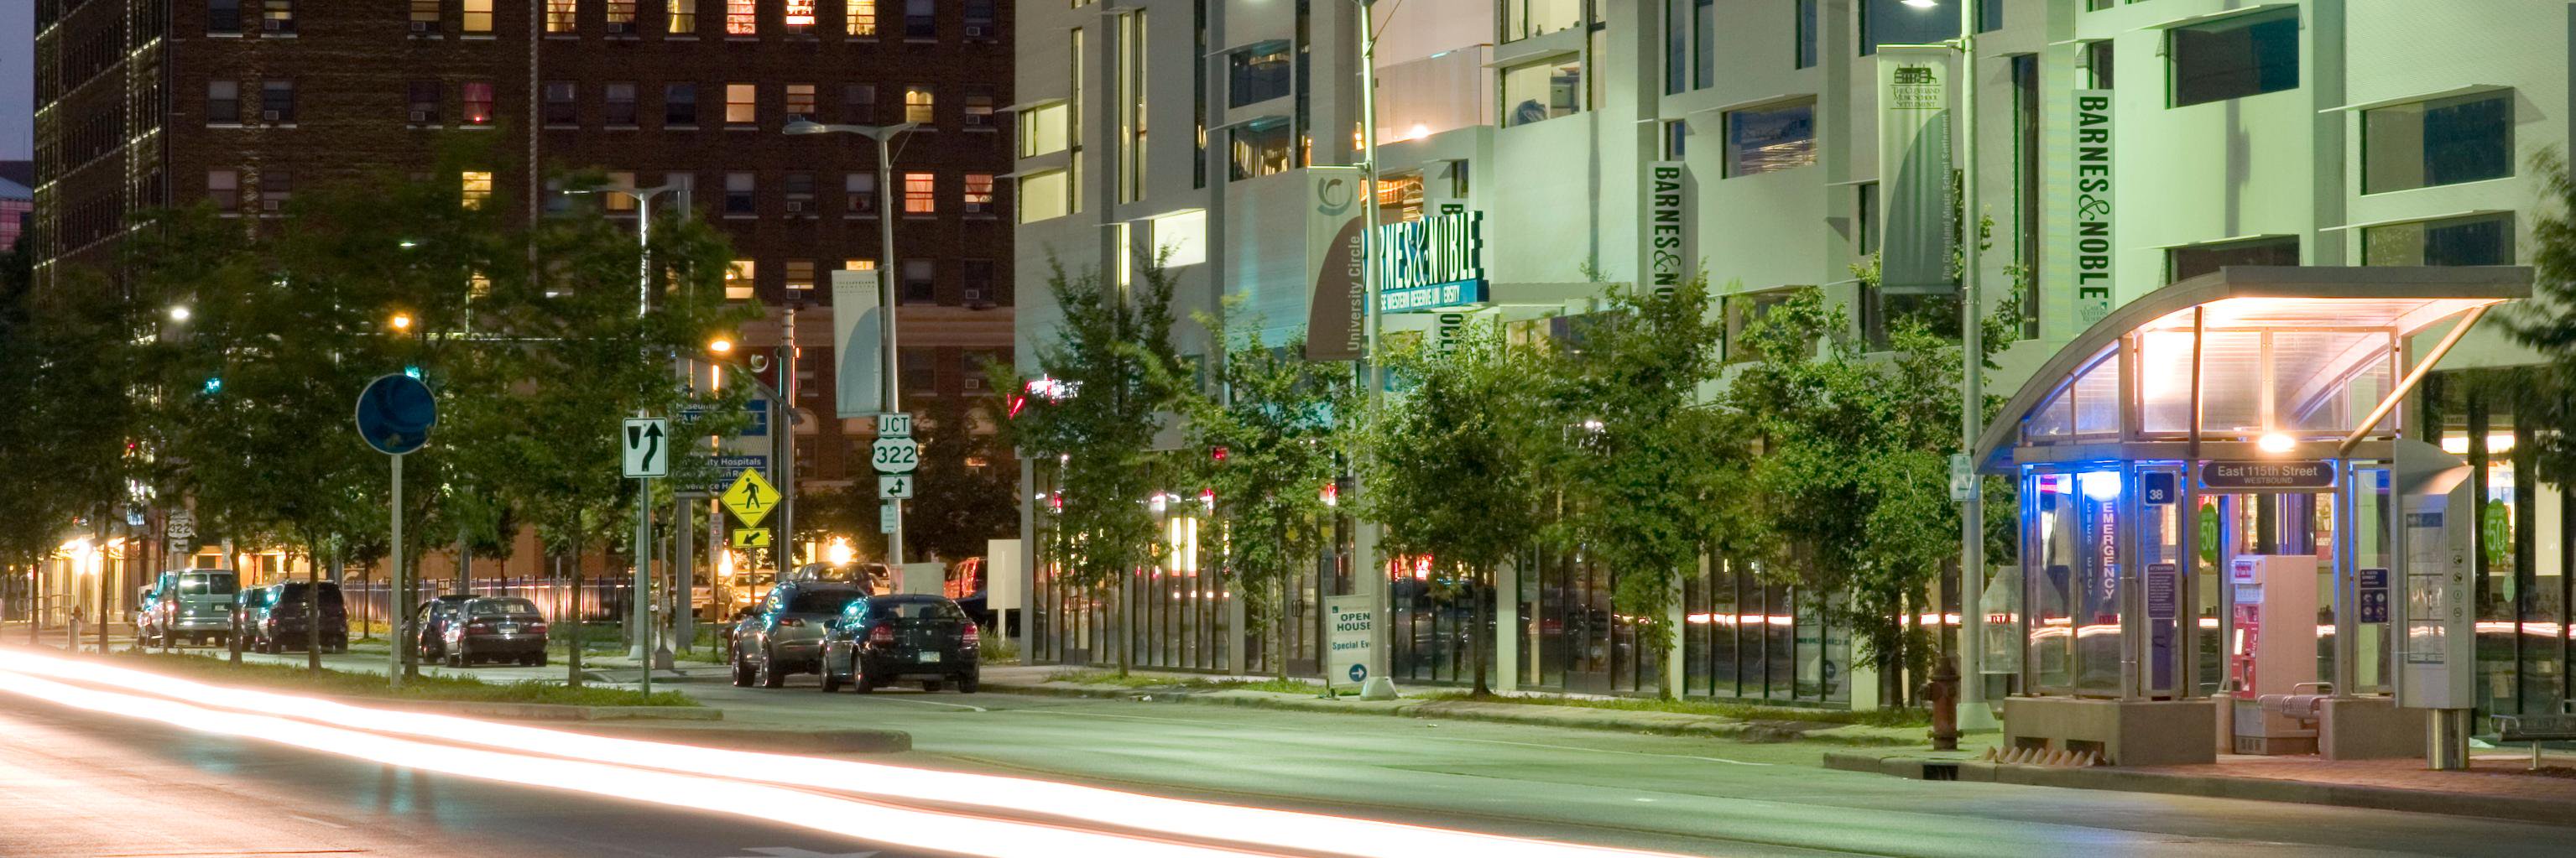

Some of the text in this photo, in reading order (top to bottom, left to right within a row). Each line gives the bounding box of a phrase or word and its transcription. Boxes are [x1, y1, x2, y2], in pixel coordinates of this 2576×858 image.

[1942, 114, 1950, 159] Settlement
[1942, 162, 1950, 190] School
[1942, 221, 1951, 263] Cleveland
[1361, 211, 1477, 293] RNES&NOBLE
[1942, 266, 1951, 281] The
[1348, 236, 1364, 351] University Circle
[881, 418, 908, 432] JCT
[722, 458, 761, 467] Hospitals
[877, 446, 914, 463] 322
[2218, 465, 2318, 476] East 115th Street
[2150, 489, 2163, 500] 38
[169, 523, 190, 533] 322
[2201, 522, 2216, 550] 50
[2103, 502, 2115, 599] EMERGENCY
[1340, 612, 1370, 621] OPEN
[1332, 641, 1358, 650] Special
